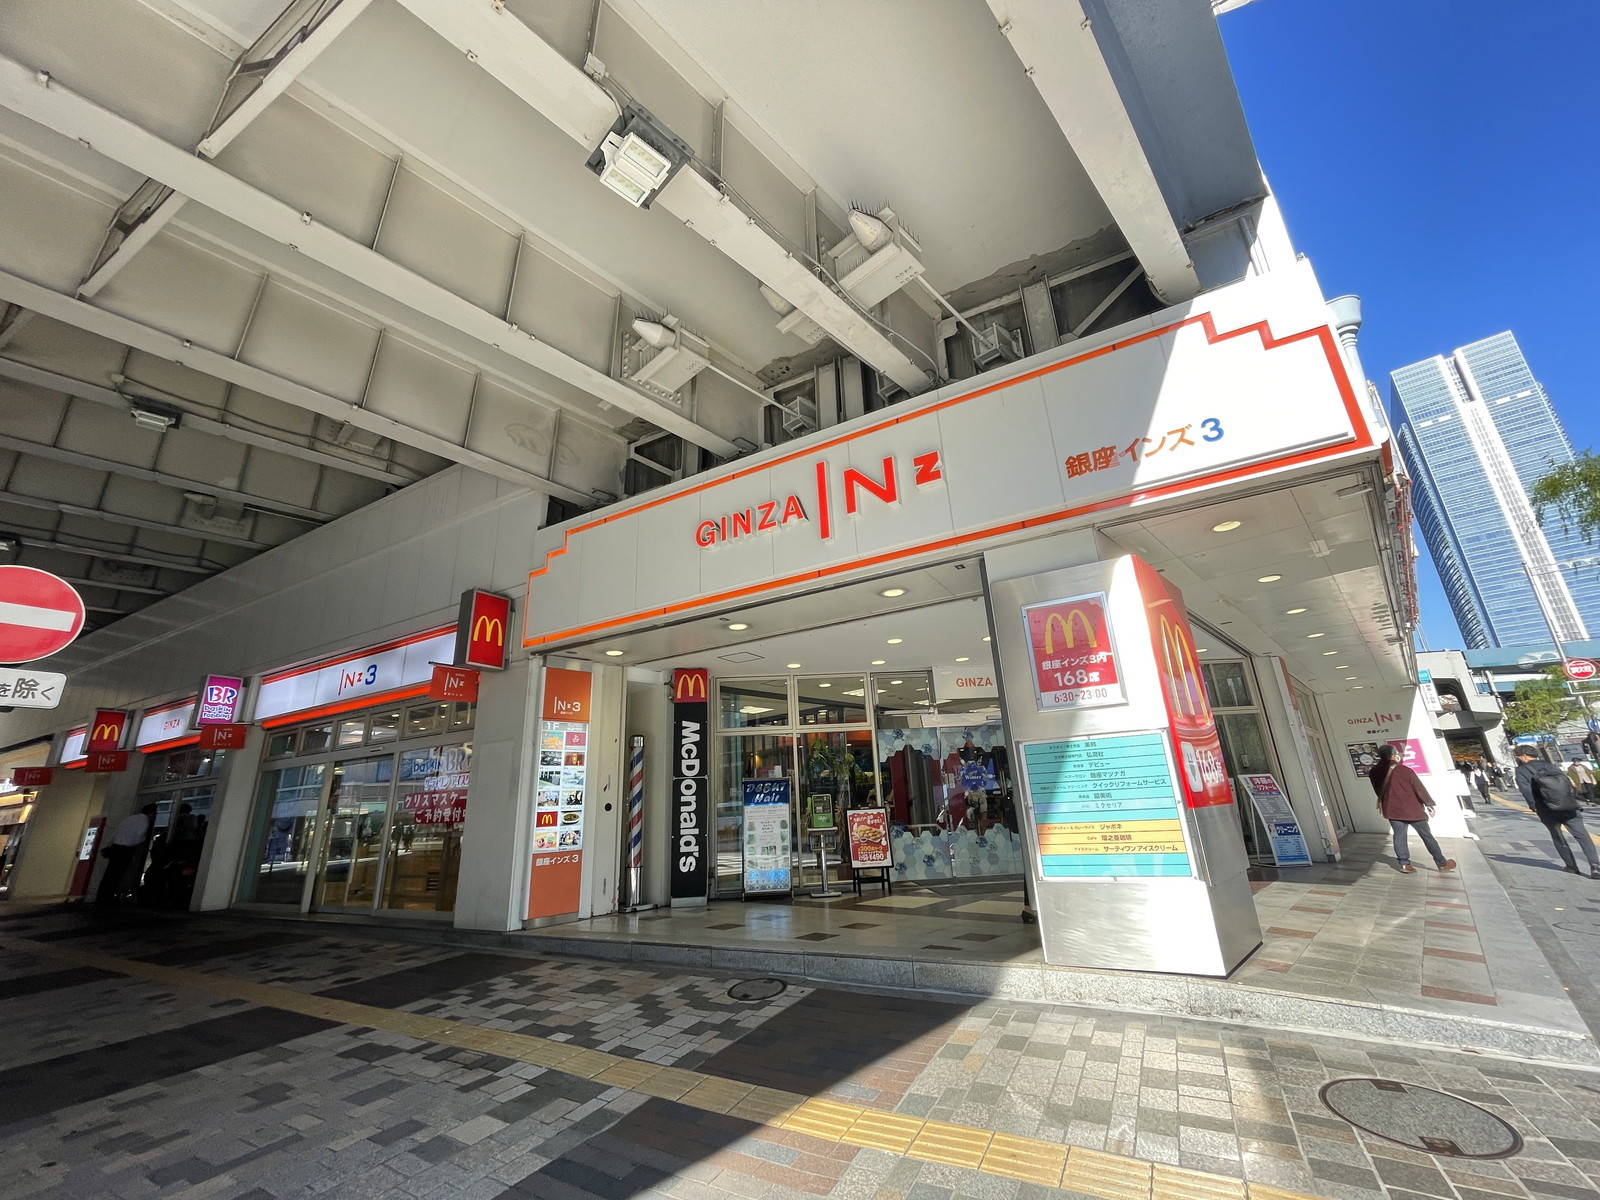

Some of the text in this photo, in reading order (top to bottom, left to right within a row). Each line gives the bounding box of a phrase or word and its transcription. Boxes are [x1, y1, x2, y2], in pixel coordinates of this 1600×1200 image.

[1065, 417, 1226, 479] 銀座インズ 3
[694, 492, 809, 549] GINZA
[956, 677, 993, 688] GINZA
[1054, 669, 1101, 687] 168席
[207, 685, 238, 704] BR
[203, 704, 232, 714] baskin
[1347, 717, 1374, 725] GINZA
[1092, 779, 1167, 789] クイックリフォームサービス
[679, 719, 701, 874] McDonald's
[1137, 844, 1179, 852] アイスクリーム
